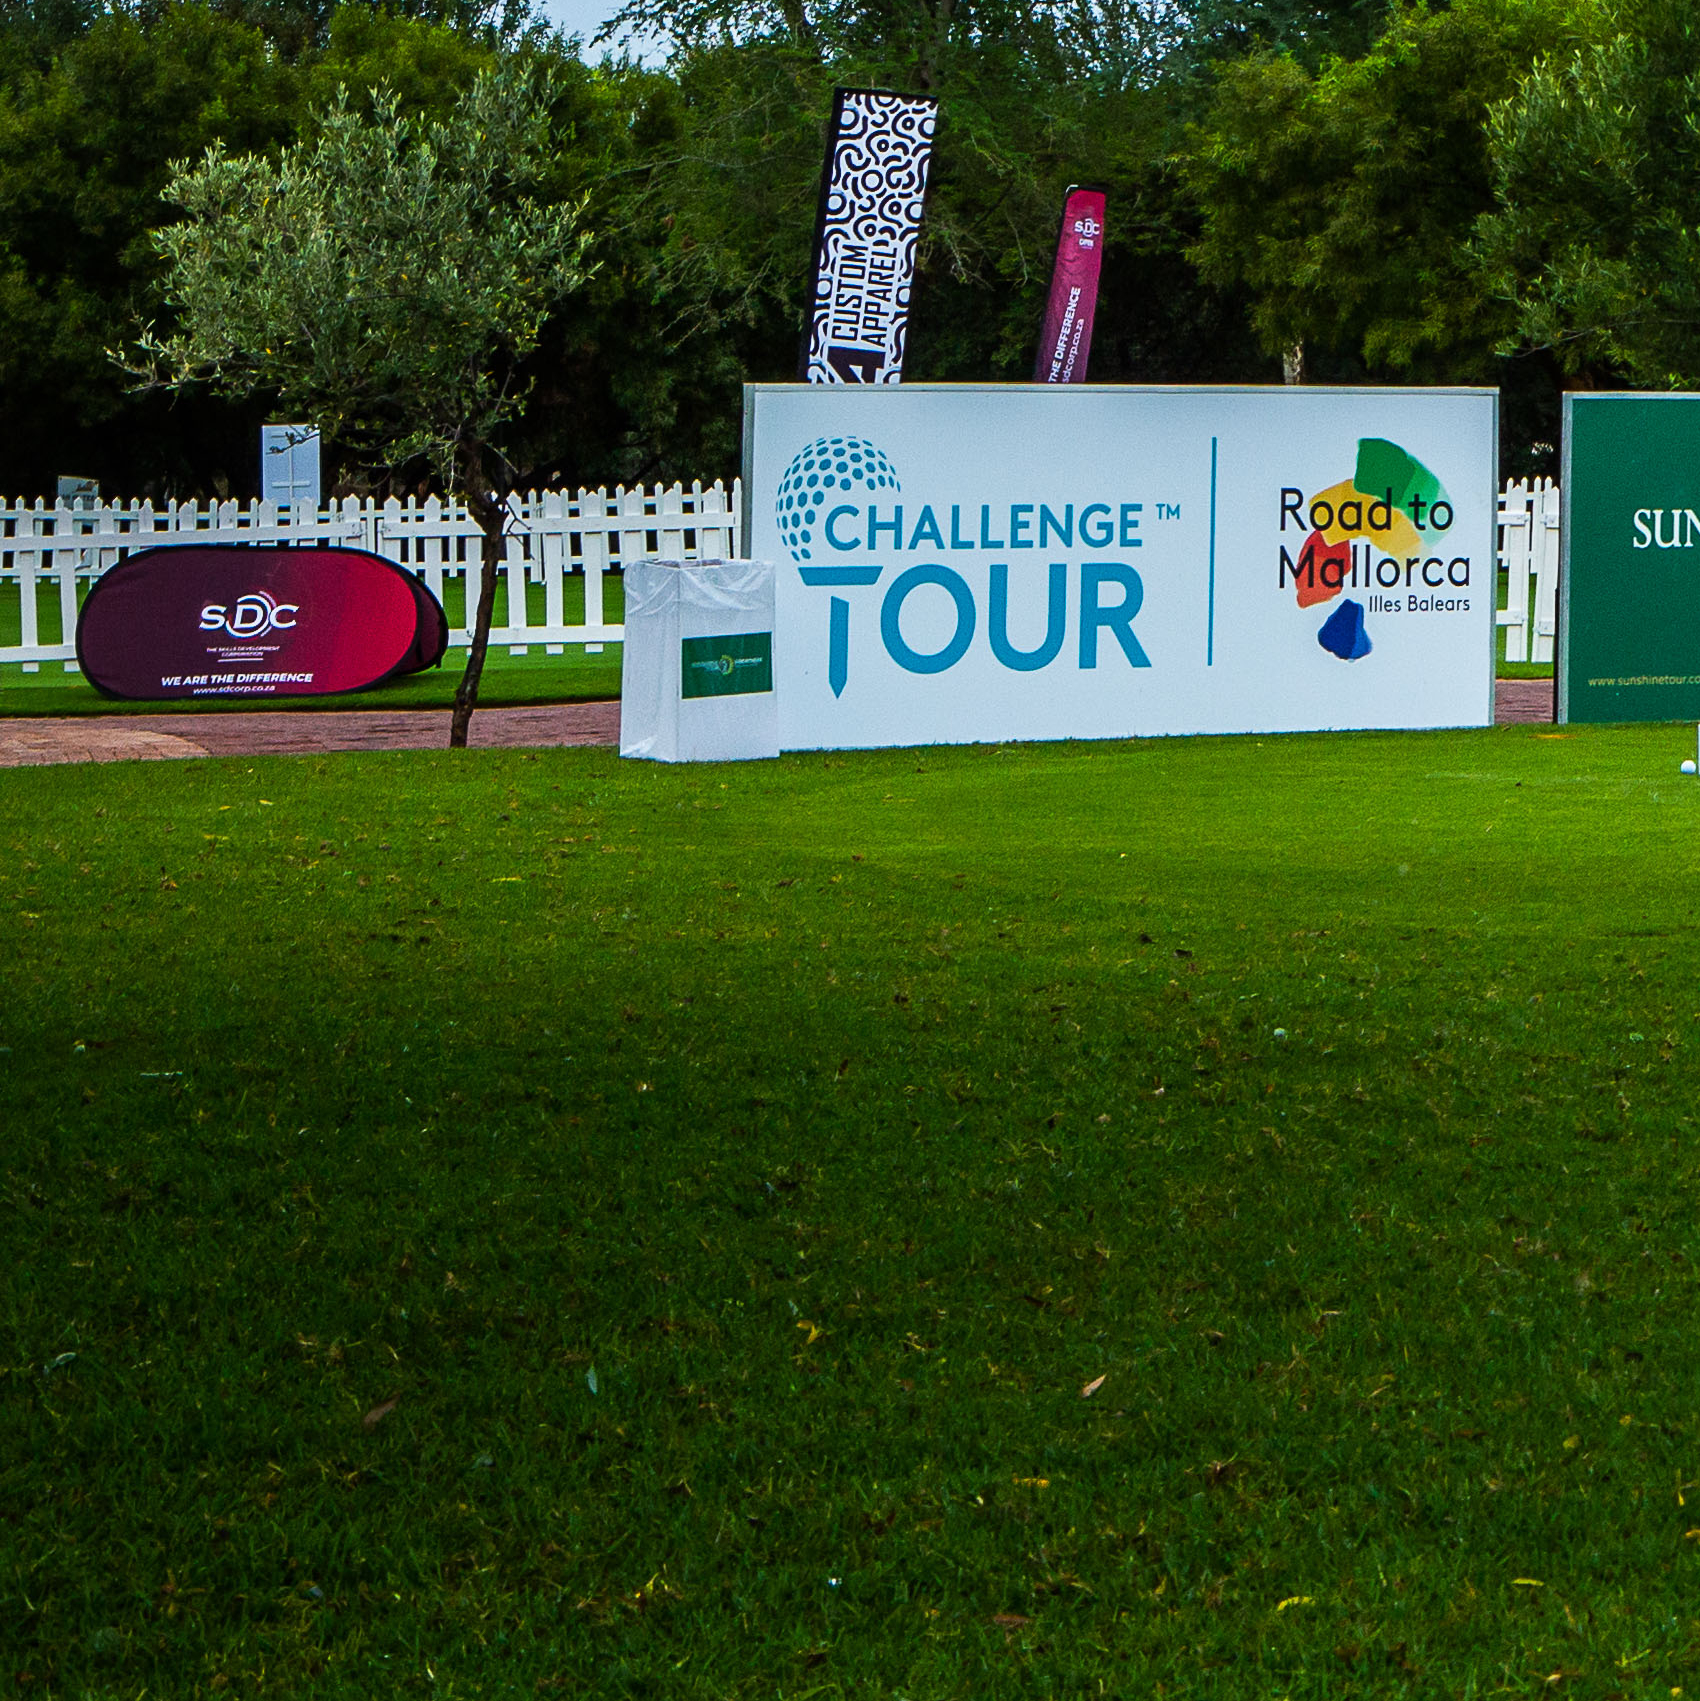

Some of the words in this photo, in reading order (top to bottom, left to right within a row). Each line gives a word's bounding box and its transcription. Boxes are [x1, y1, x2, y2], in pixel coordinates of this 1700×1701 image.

[1074, 220, 1100, 235] SDC
[831, 244, 868, 342] CUSTOM
[861, 247, 897, 347] APPAREL
[1054, 286, 1081, 360] DIFFERENCE
[1048, 360, 1061, 382] THE
[824, 503, 1143, 551] CHALLENGE
[1279, 487, 1393, 532] Road
[1408, 493, 1454, 531] to
[1279, 544, 1470, 589] Mallorca
[199, 604, 300, 630] SDC
[1369, 595, 1401, 613] Illes
[1408, 594, 1470, 612] Balears
[797, 562, 1152, 699] TOUR
[161, 676, 182, 687] WE
[182, 675, 208, 685] ARE
[210, 674, 234, 684] THE
[236, 673, 314, 683] DIFFERENCE
[193, 684, 276, 694] www.sdcorp.co.za
